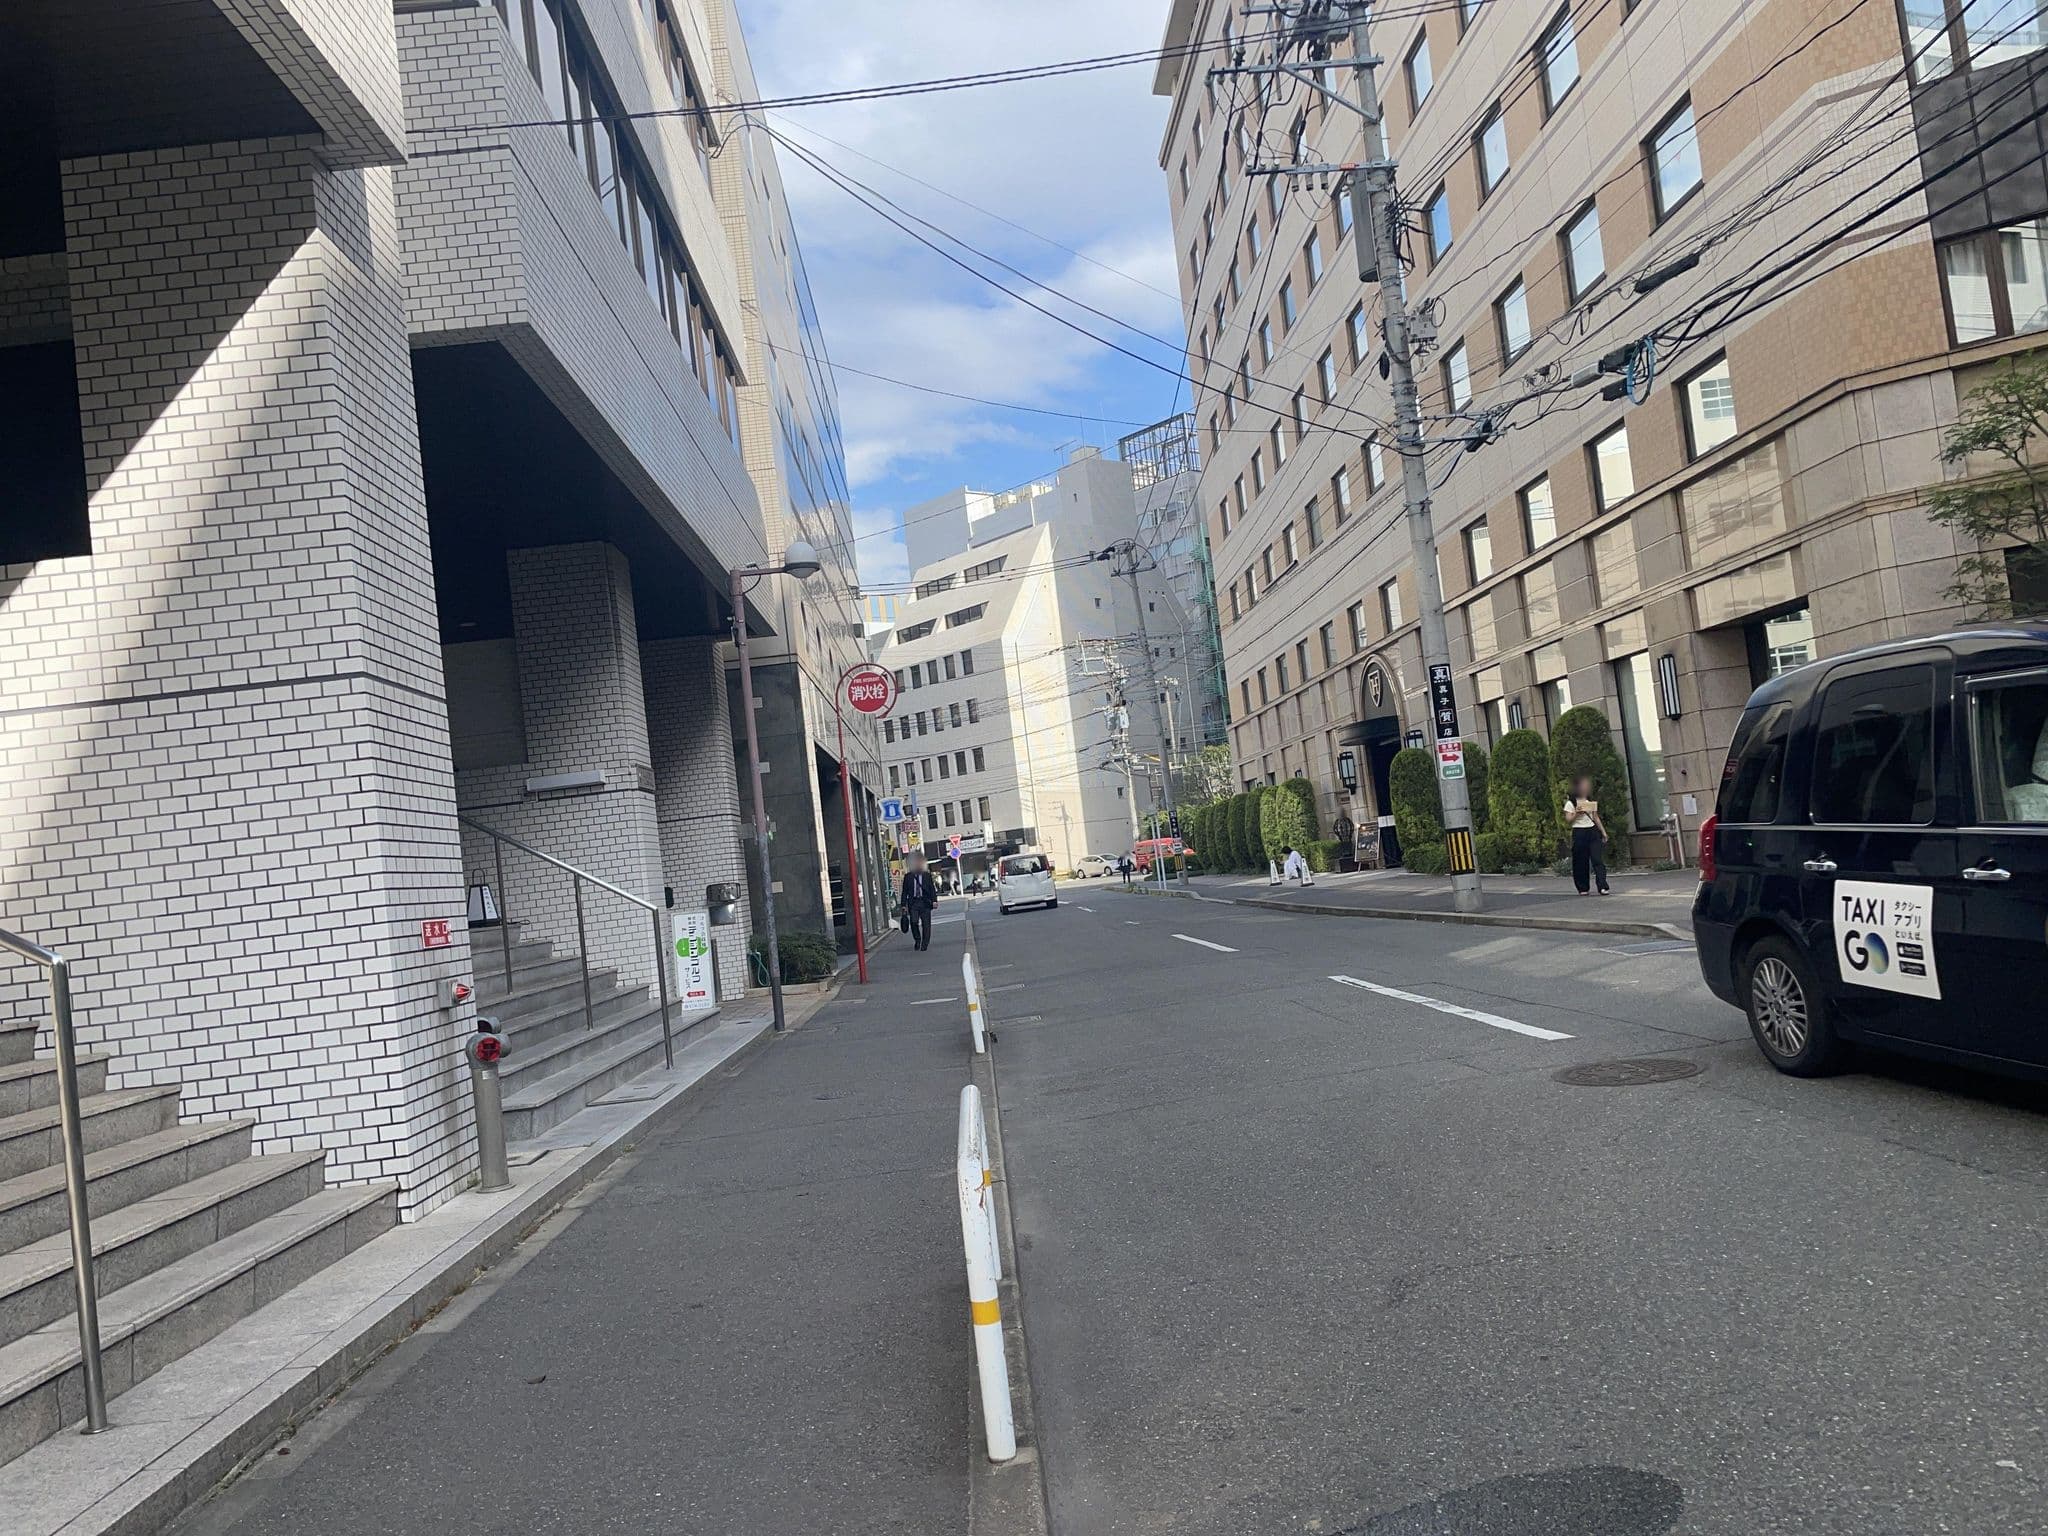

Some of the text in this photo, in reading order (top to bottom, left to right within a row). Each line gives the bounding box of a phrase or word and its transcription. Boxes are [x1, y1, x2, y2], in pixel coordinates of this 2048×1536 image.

[850, 683, 886, 702] 消火栓
[1841, 896, 1885, 926] TAXI
[1894, 900, 1922, 912] タクシー
[1894, 914, 1922, 929] アプリ
[1844, 929, 1890, 975] GO
